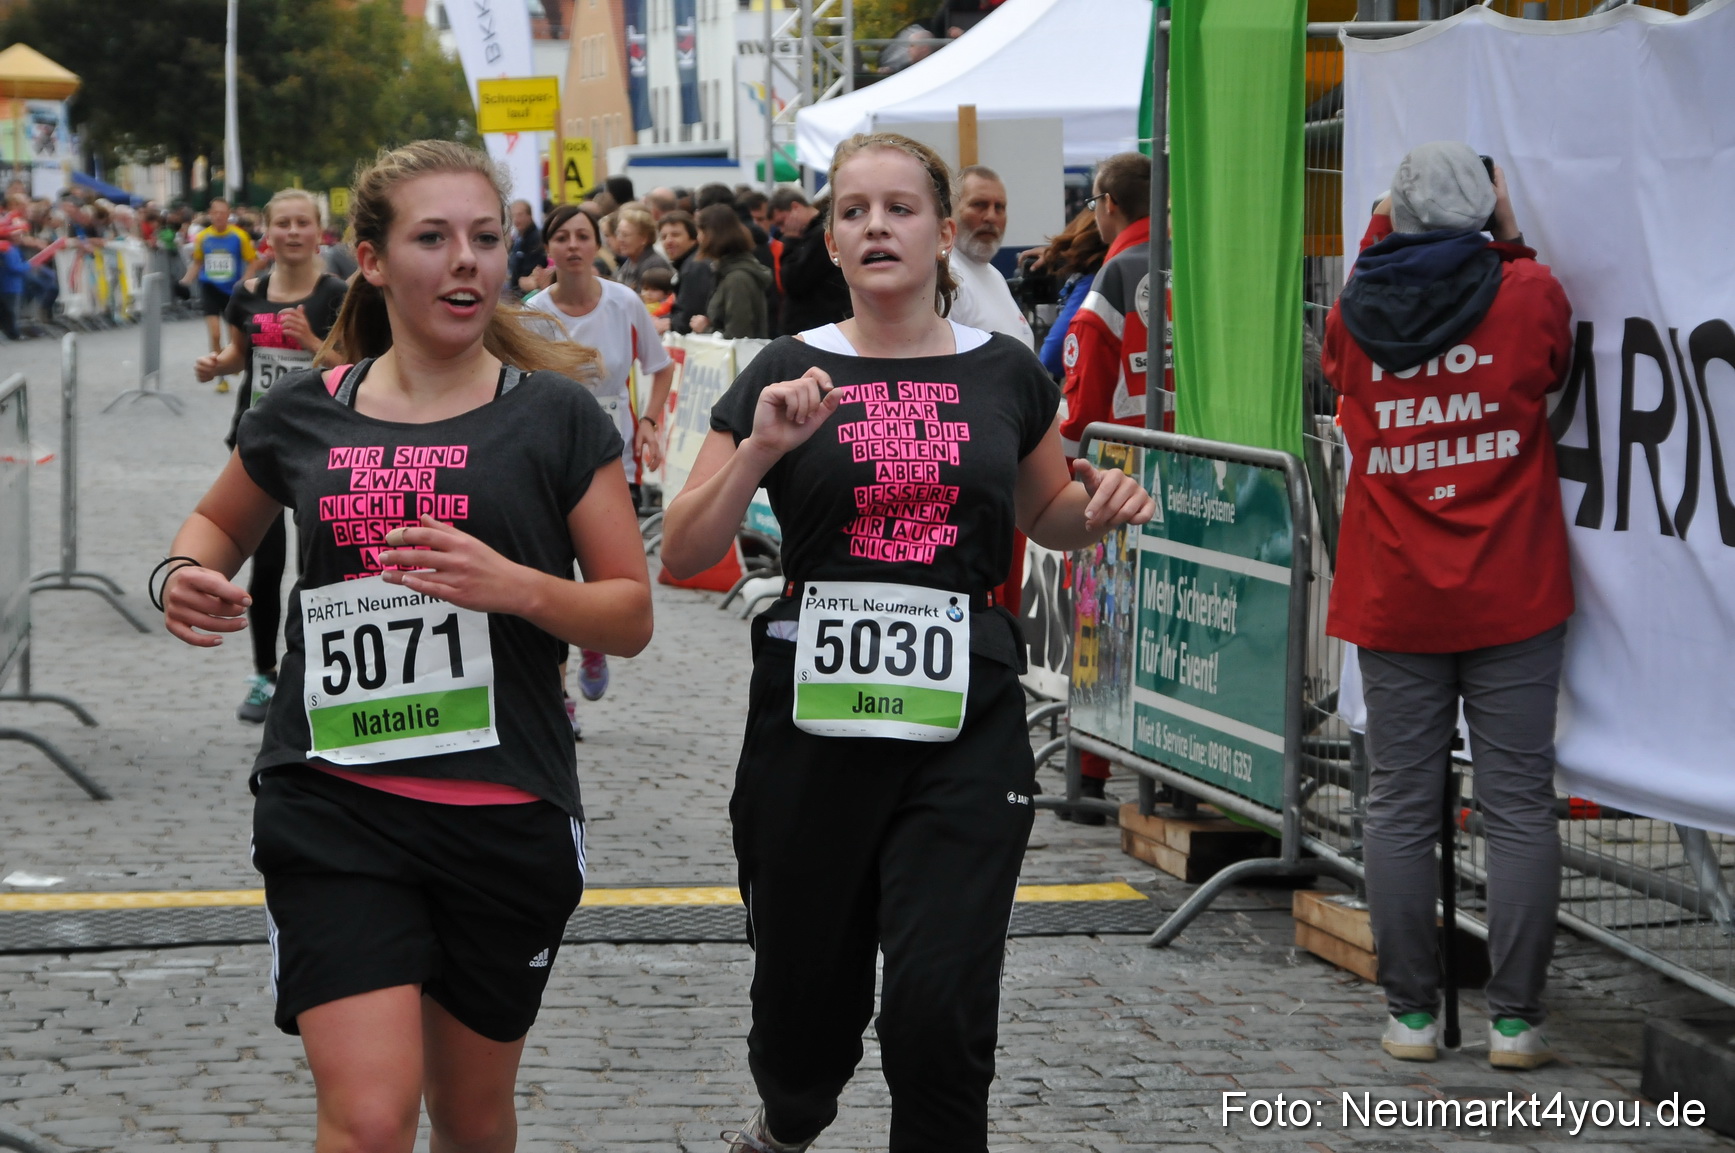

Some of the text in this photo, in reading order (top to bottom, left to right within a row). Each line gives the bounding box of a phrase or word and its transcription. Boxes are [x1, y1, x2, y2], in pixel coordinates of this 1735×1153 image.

[482, 93, 554, 105] Schnupper-
[507, 107, 530, 119] lauf
[565, 141, 588, 152] lock
[564, 157, 583, 188] A
[840, 382, 959, 404] WIR SIND
[866, 402, 938, 420] ZWAR
[1375, 392, 1499, 429] TEAM-
[838, 421, 969, 443] NICHT DIE
[329, 446, 467, 469] WIR SIND
[853, 440, 959, 465] BESTEN,
[1366, 430, 1520, 474] MUELLER
[351, 469, 434, 491] ZWAR
[876, 462, 939, 483] ABER
[855, 485, 959, 507] BESSERE
[1428, 485, 1456, 500] .DE
[320, 493, 468, 521] NICHT DIE
[893, 520, 958, 546] AUCH
[851, 537, 935, 564] NICHT!
[307, 600, 354, 624] PARTL
[805, 598, 939, 617] PARTL Neumarkt
[1143, 567, 1237, 634] Mehr Sicherheit
[321, 612, 465, 696] 5071
[814, 619, 953, 681] 5030
[1140, 627, 1219, 694] für Ihr Event!
[852, 691, 904, 715] Jana
[352, 703, 440, 737] Natalie
[1155, 722, 1162, 748] &
[1163, 724, 1188, 758] Service
[1208, 741, 1231, 774] 09181
